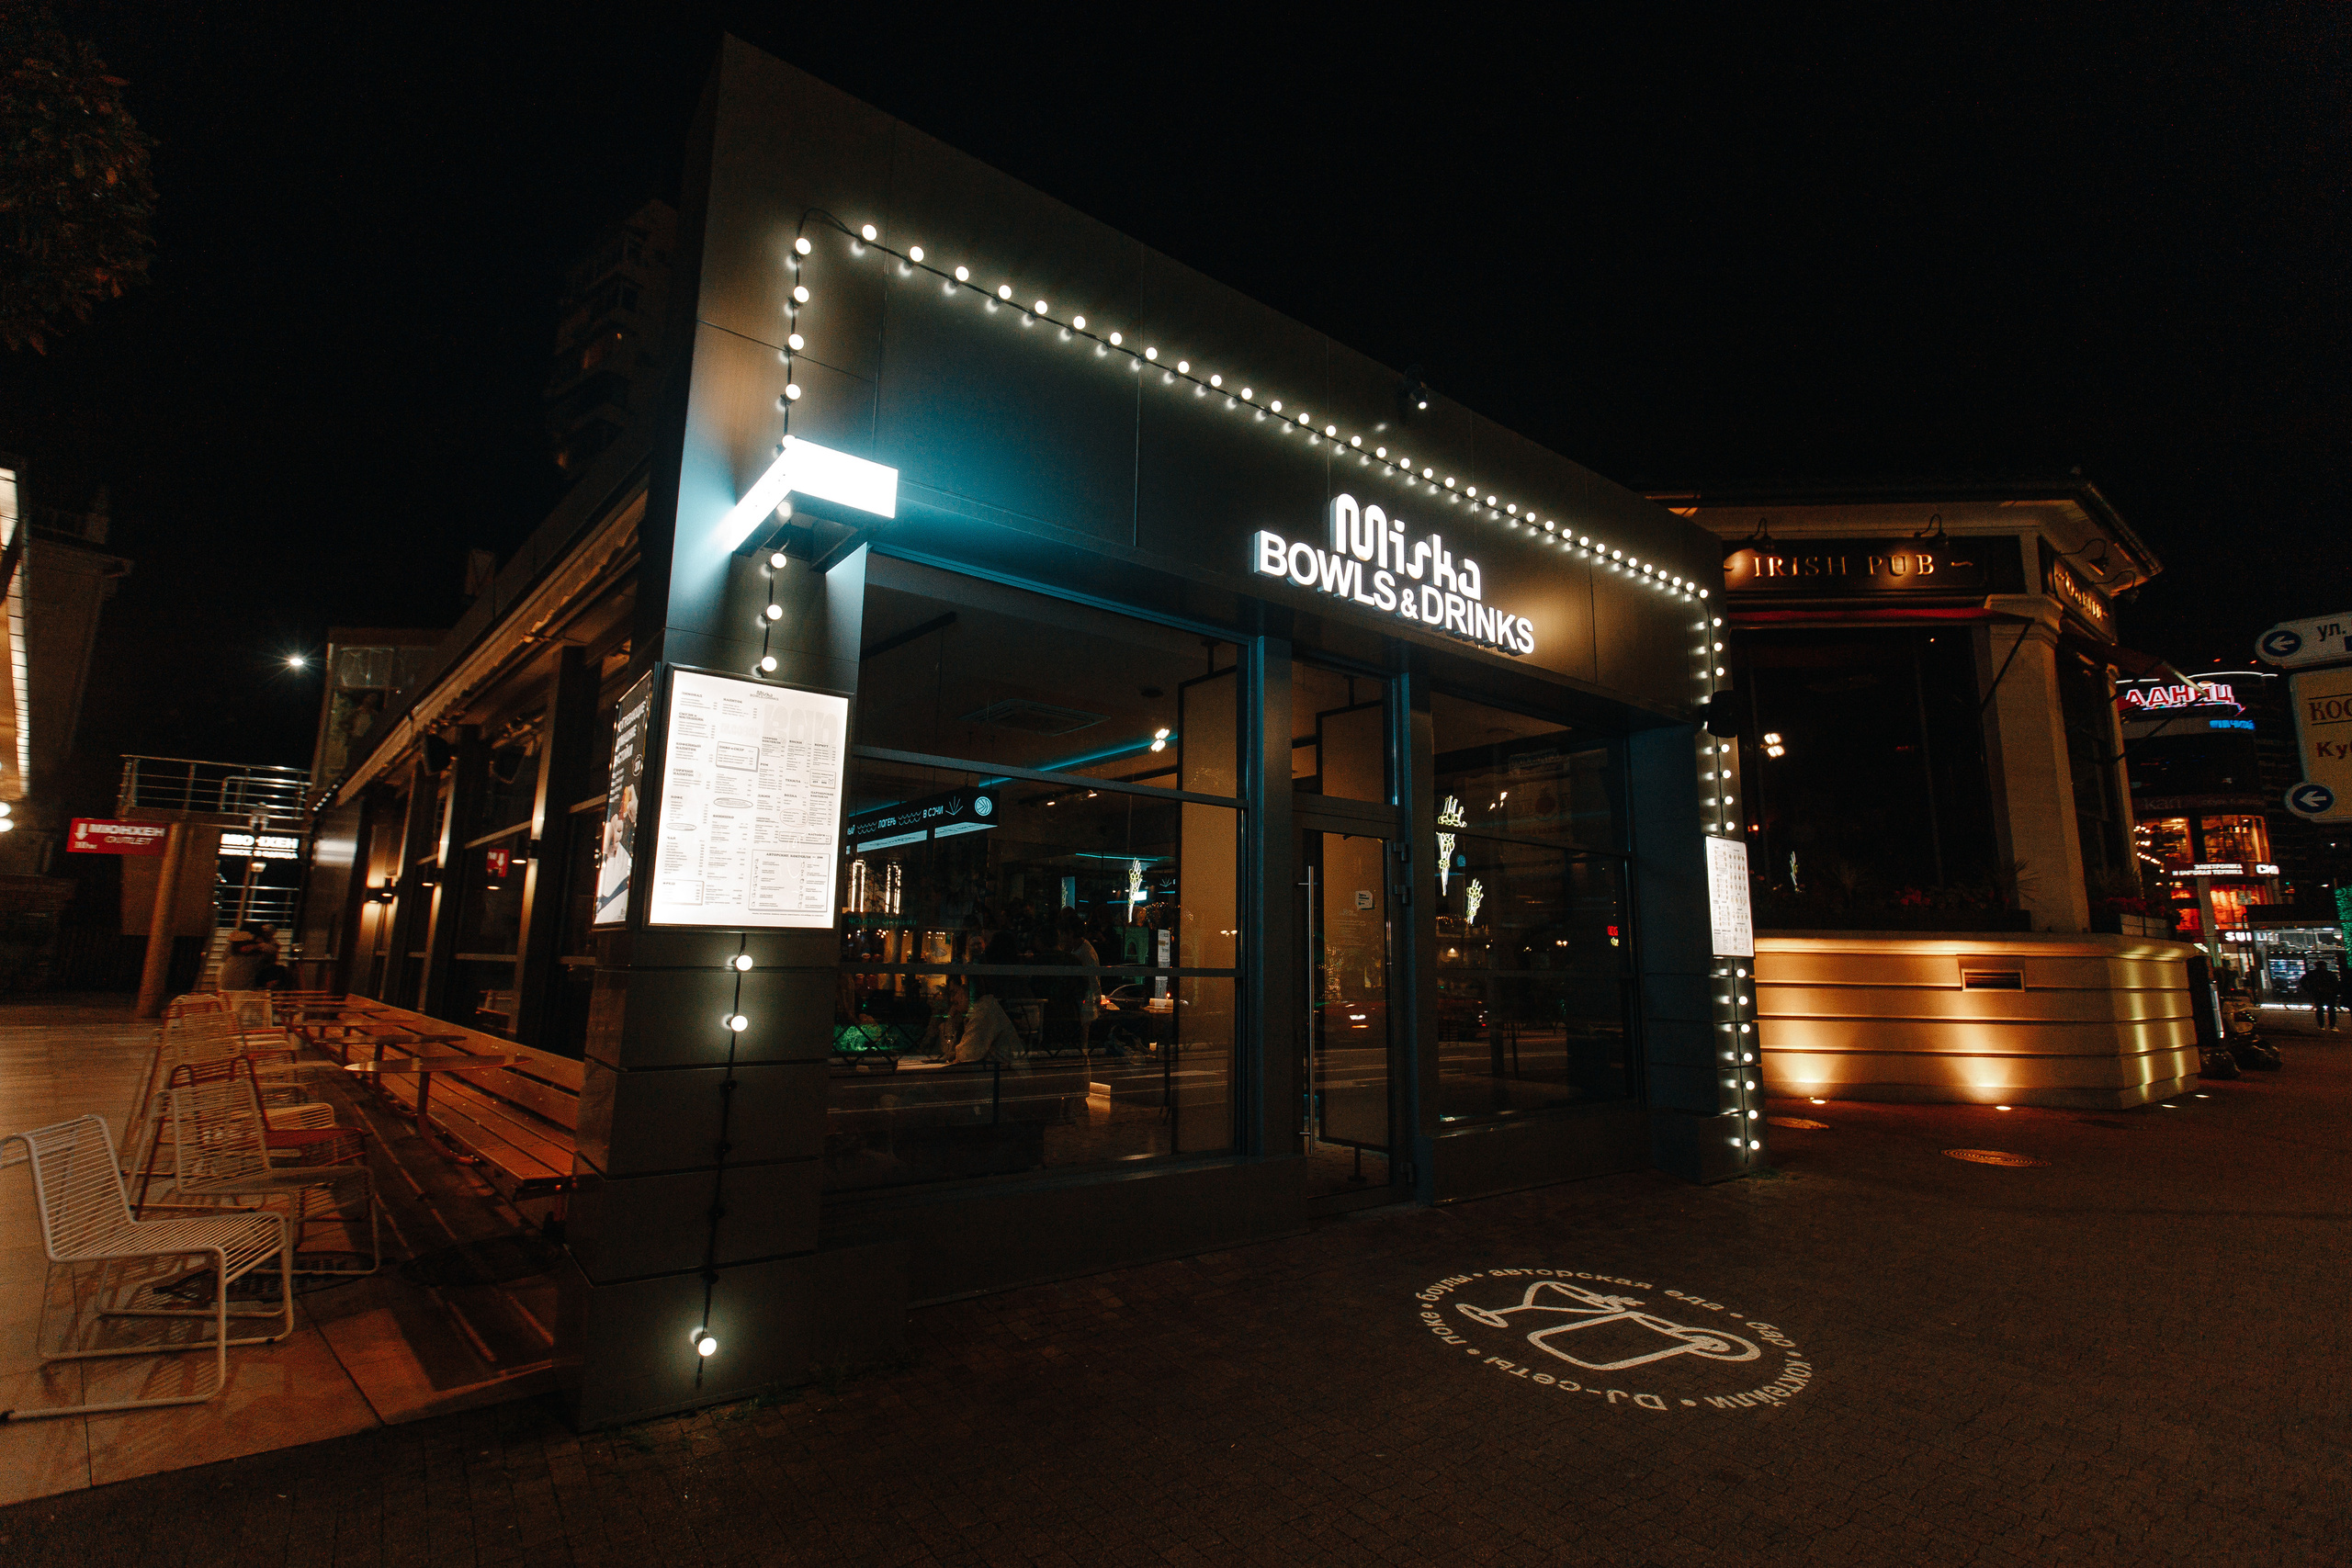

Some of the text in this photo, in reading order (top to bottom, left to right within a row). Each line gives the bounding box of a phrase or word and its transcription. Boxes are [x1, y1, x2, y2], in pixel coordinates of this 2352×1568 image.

[1330, 493, 1481, 600] Miska
[1753, 554, 1935, 578] IRISH PUB
[1488, 1269, 1653, 1291] авторская
